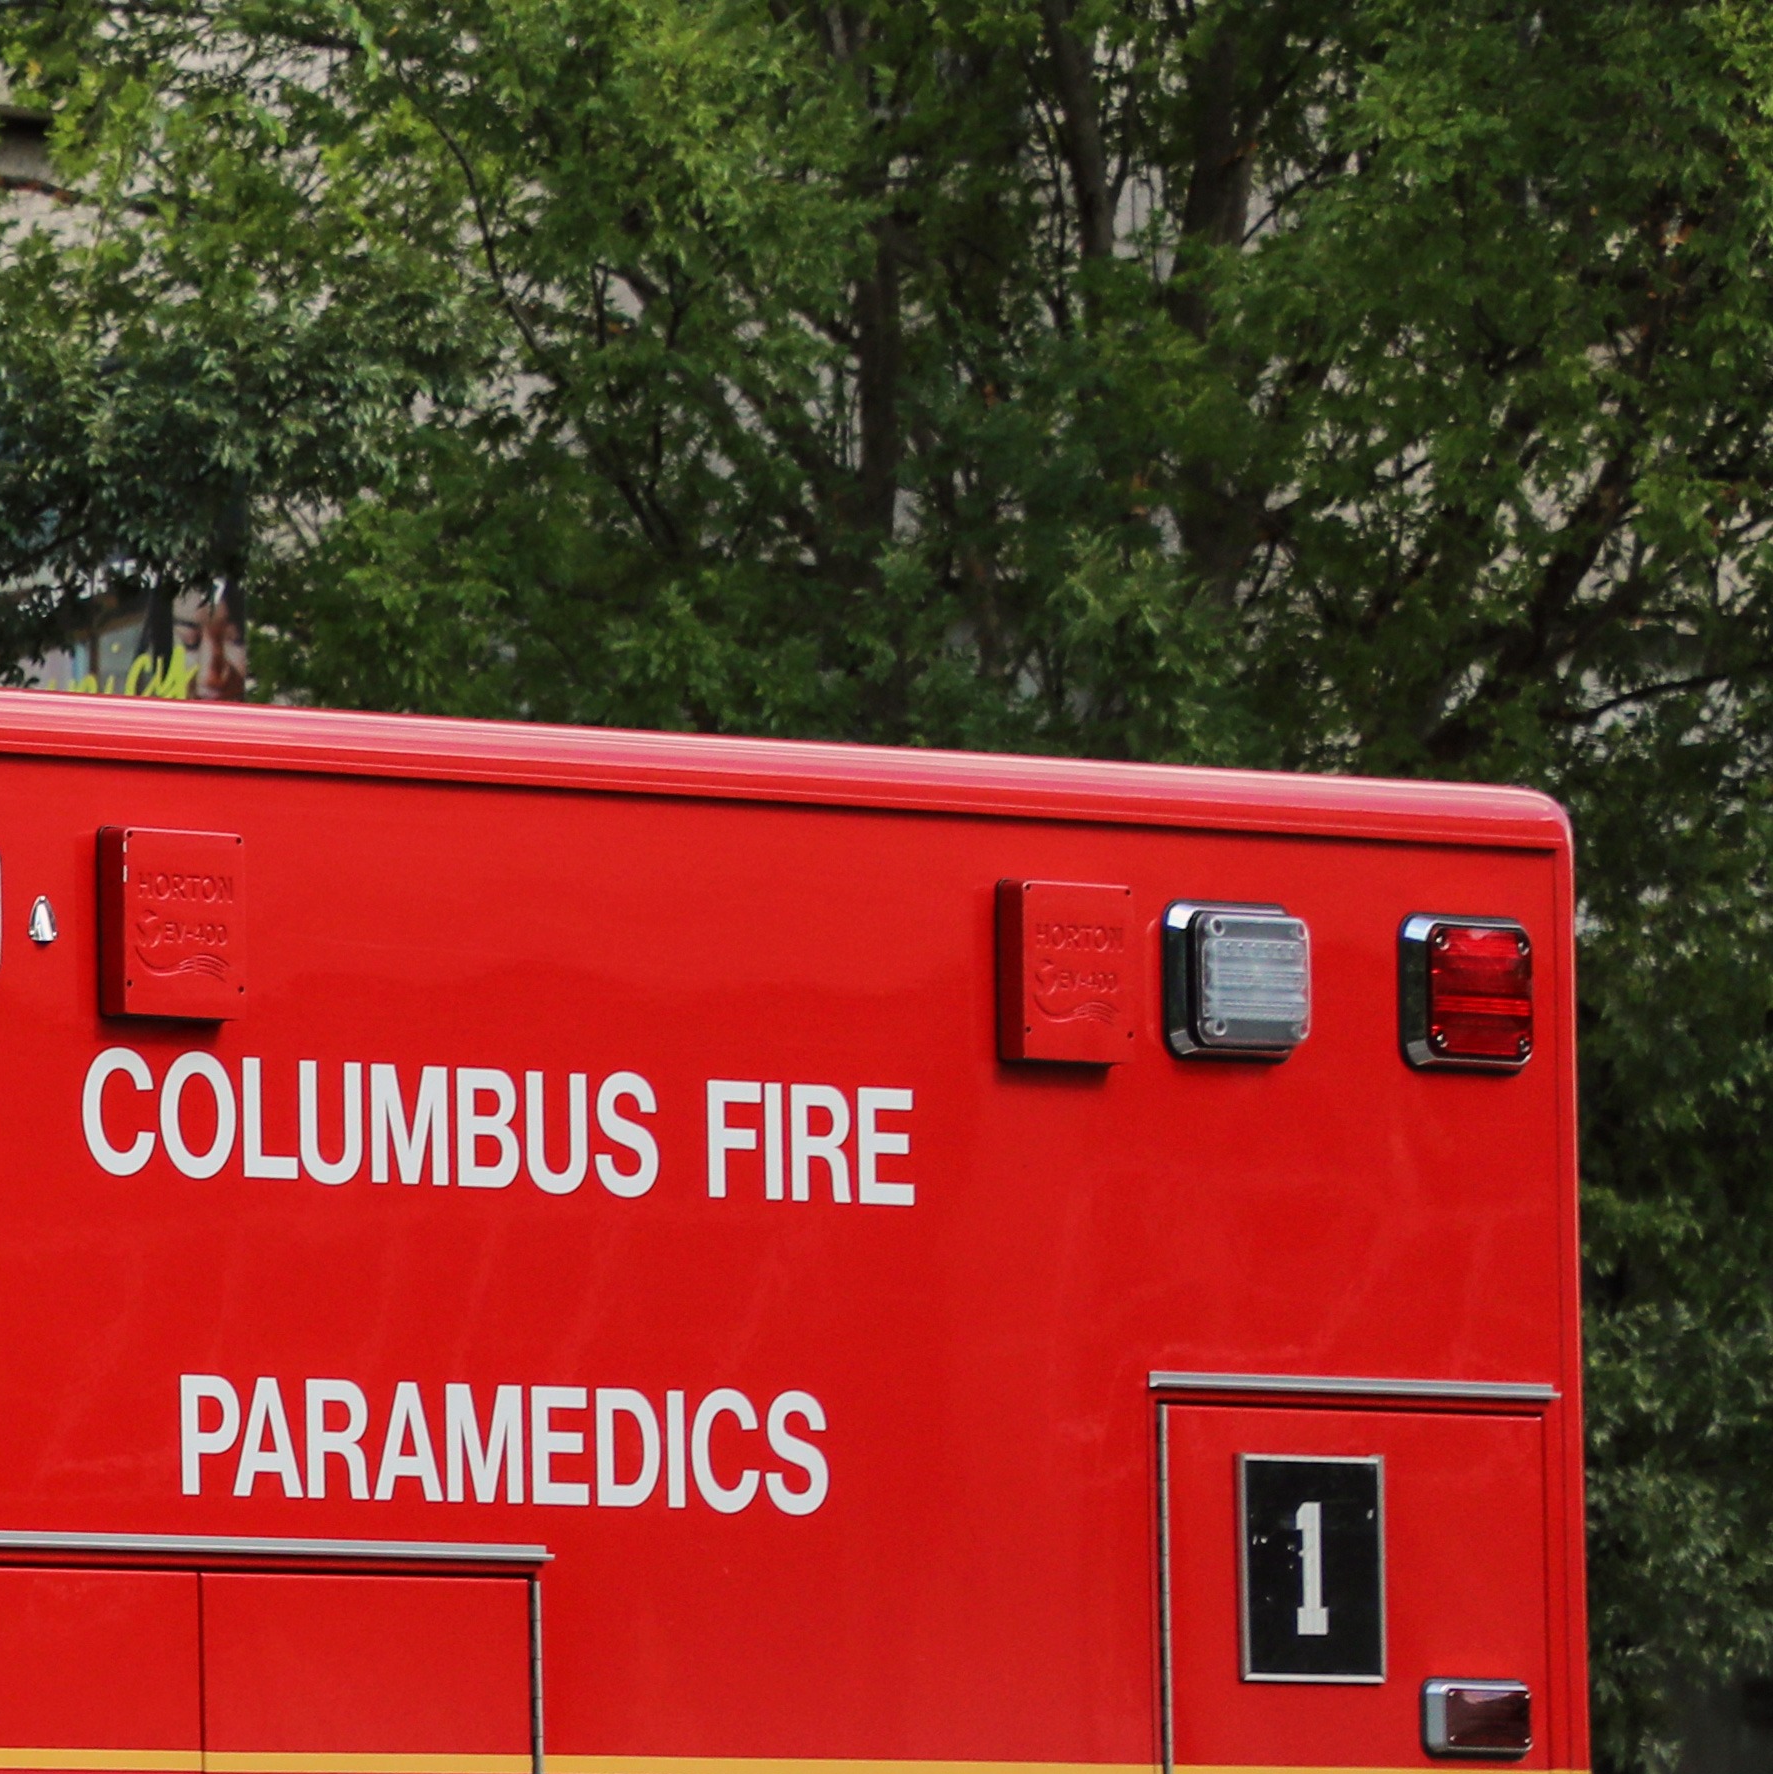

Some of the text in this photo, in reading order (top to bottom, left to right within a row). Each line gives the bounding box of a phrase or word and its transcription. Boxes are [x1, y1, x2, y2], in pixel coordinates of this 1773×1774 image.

[138, 872, 233, 904] HORTON
[164, 921, 228, 946] EV-400
[1035, 923, 1124, 953] HORTON
[81, 1046, 914, 1206] COLUMBUS FIRE
[179, 1373, 829, 1515] PARAMEDICS
[1295, 1501, 1329, 1636] 1
